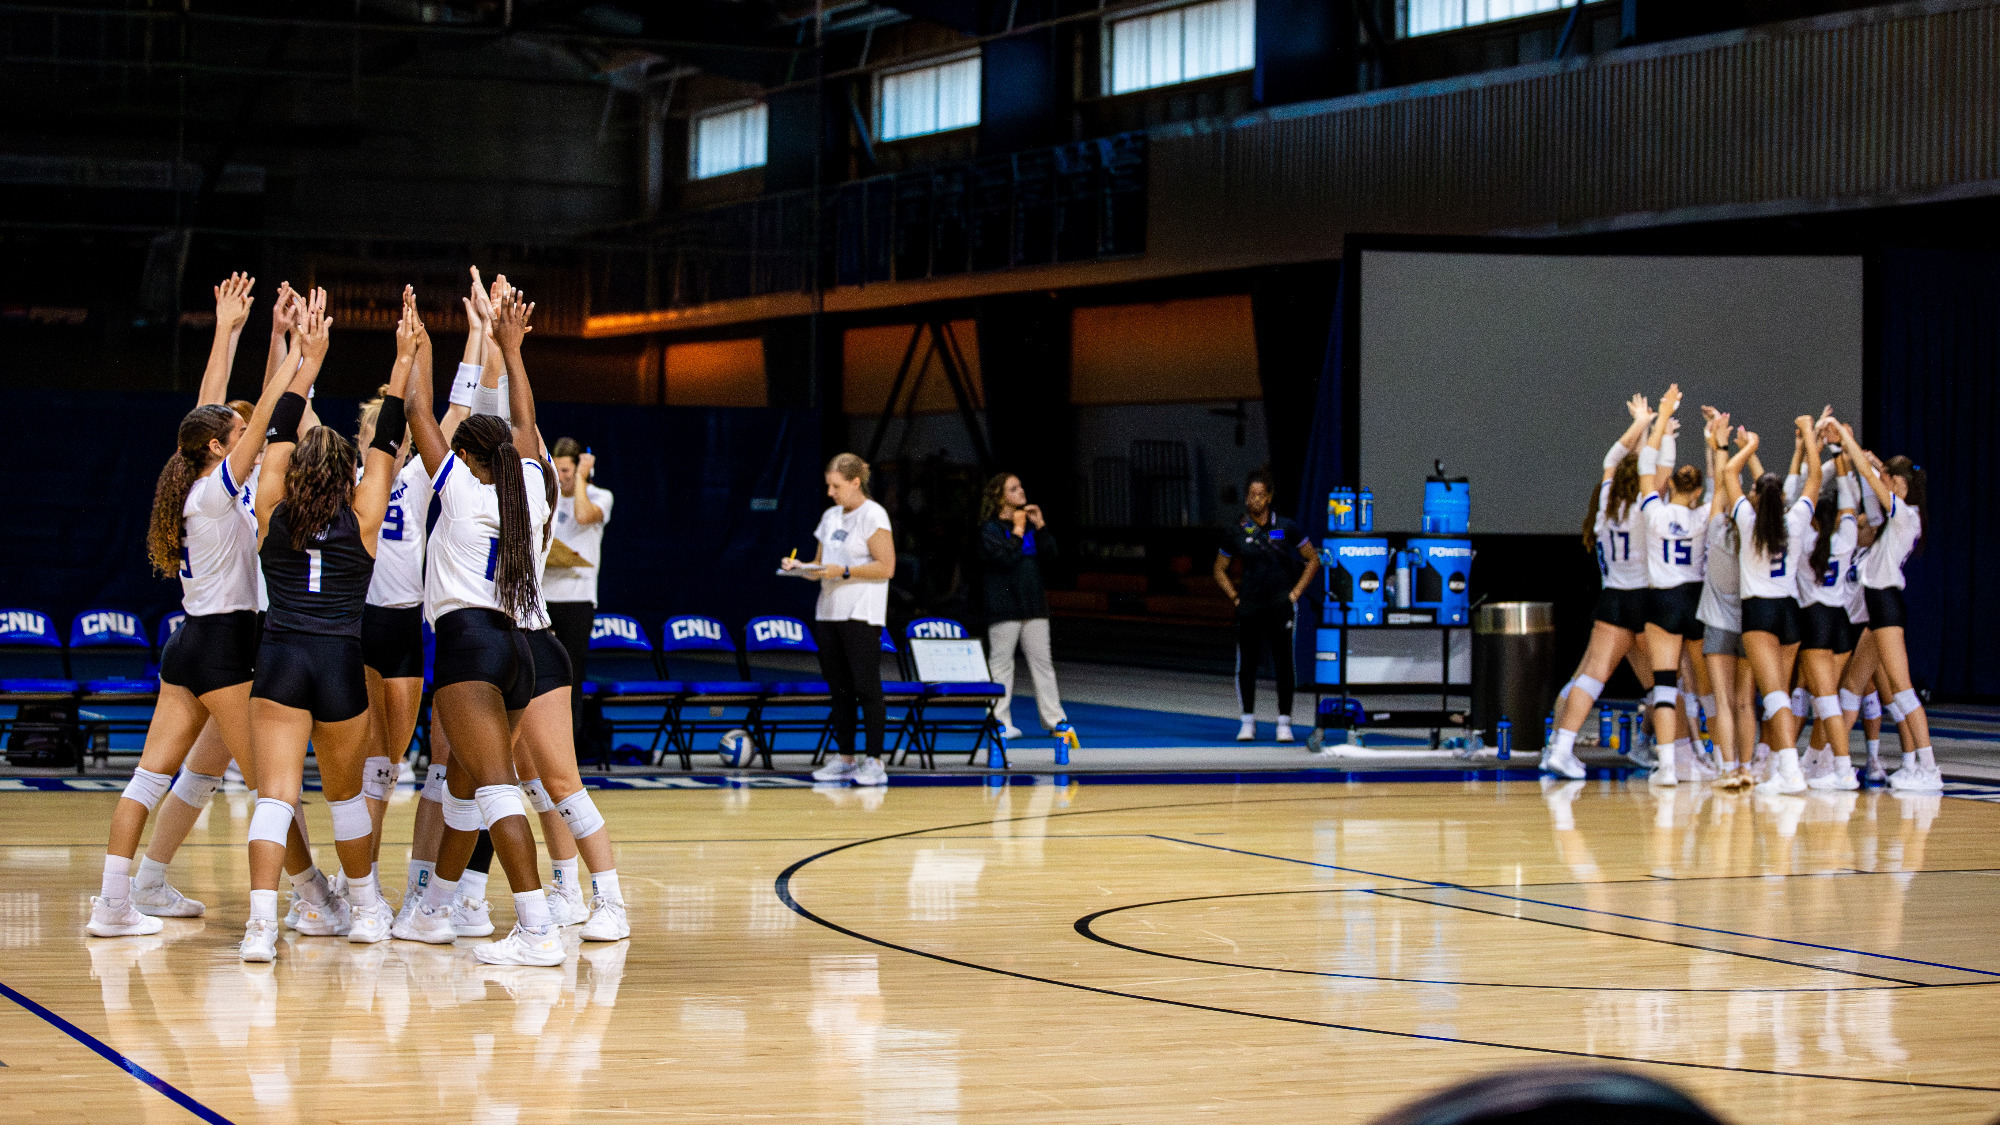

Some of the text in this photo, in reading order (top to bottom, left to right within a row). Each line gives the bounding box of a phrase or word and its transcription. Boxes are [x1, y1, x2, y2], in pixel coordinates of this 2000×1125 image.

[382, 505, 404, 541] 9
[1609, 530, 1629, 561] 17
[1663, 538, 1693, 565] 15
[306, 549, 321, 592] 1
[80, 611, 136, 636] CNU
[671, 618, 722, 640] CNU
[753, 619, 804, 642] CNU
[913, 621, 962, 638] CNU
